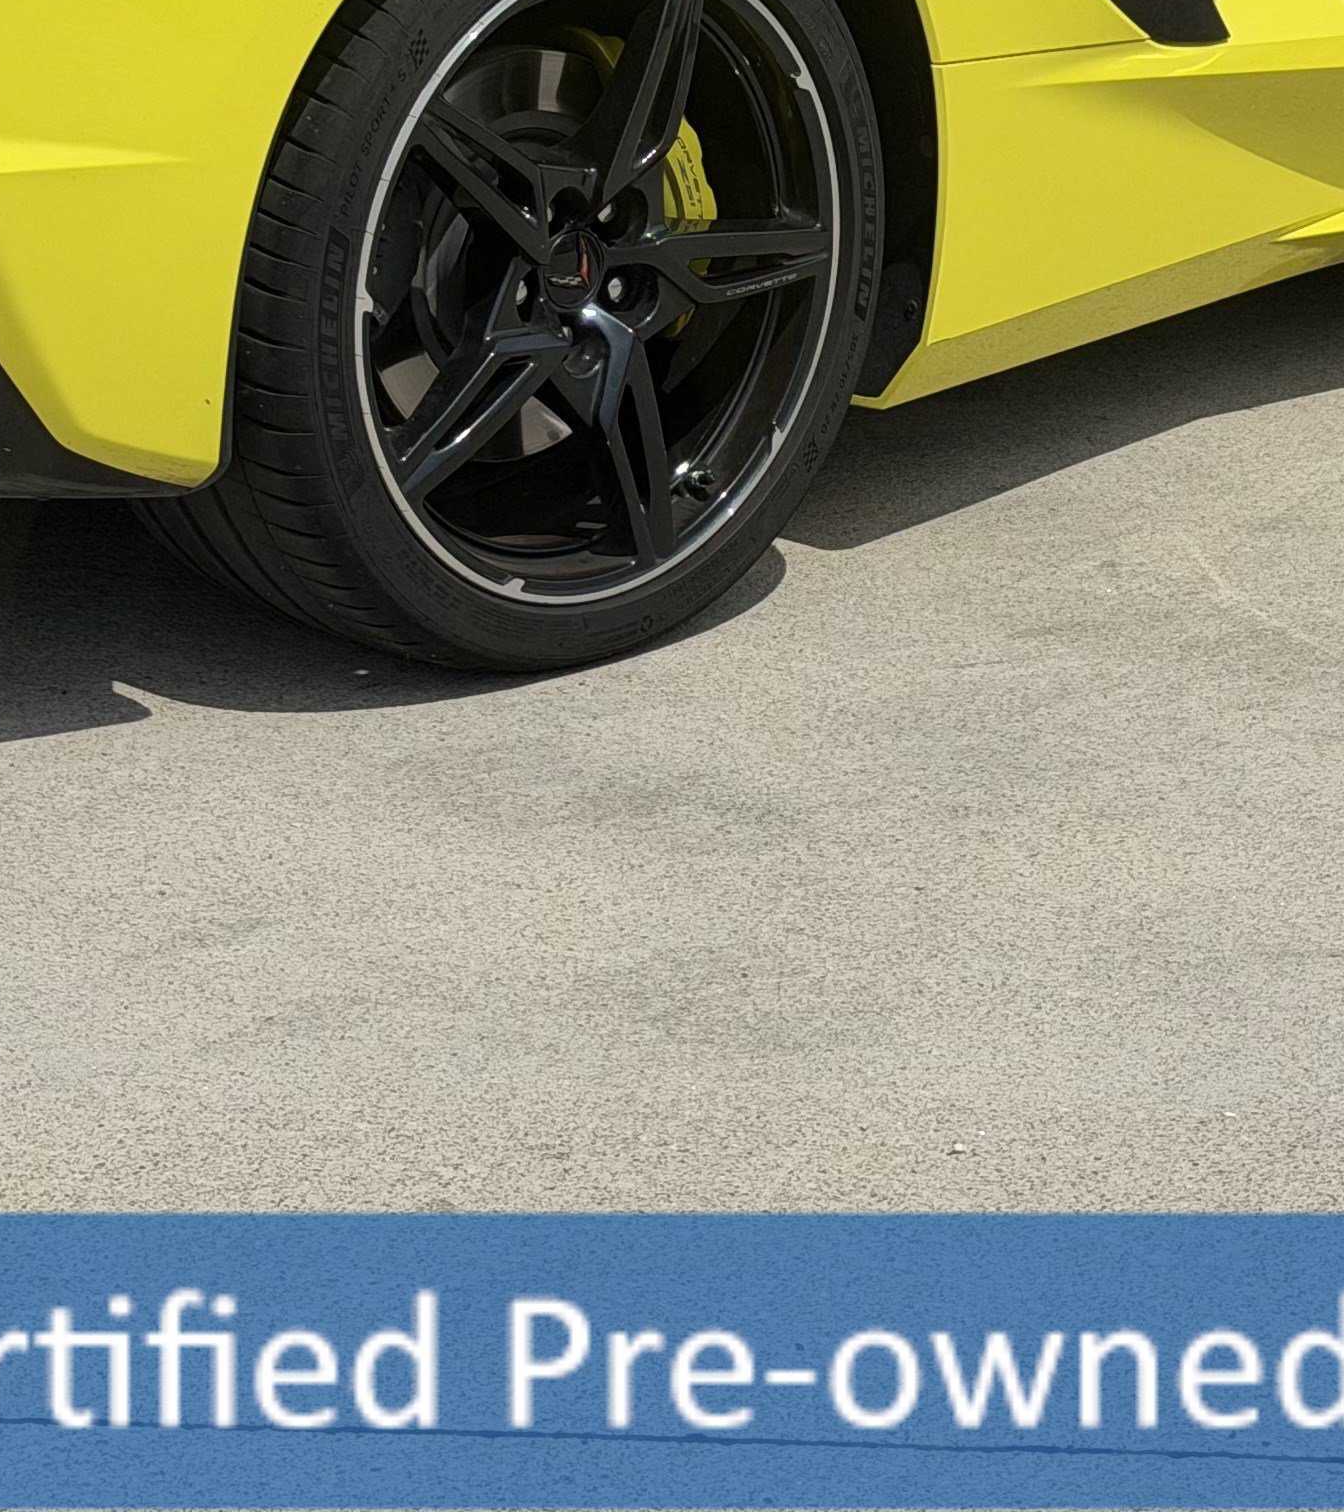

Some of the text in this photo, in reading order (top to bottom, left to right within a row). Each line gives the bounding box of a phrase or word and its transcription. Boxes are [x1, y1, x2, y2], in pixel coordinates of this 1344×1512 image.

[341, 164, 363, 218] PILOT
[360, 96, 391, 157] SPORT
[857, 126, 876, 308] MICHELIN
[319, 241, 348, 441] MICHELIN
